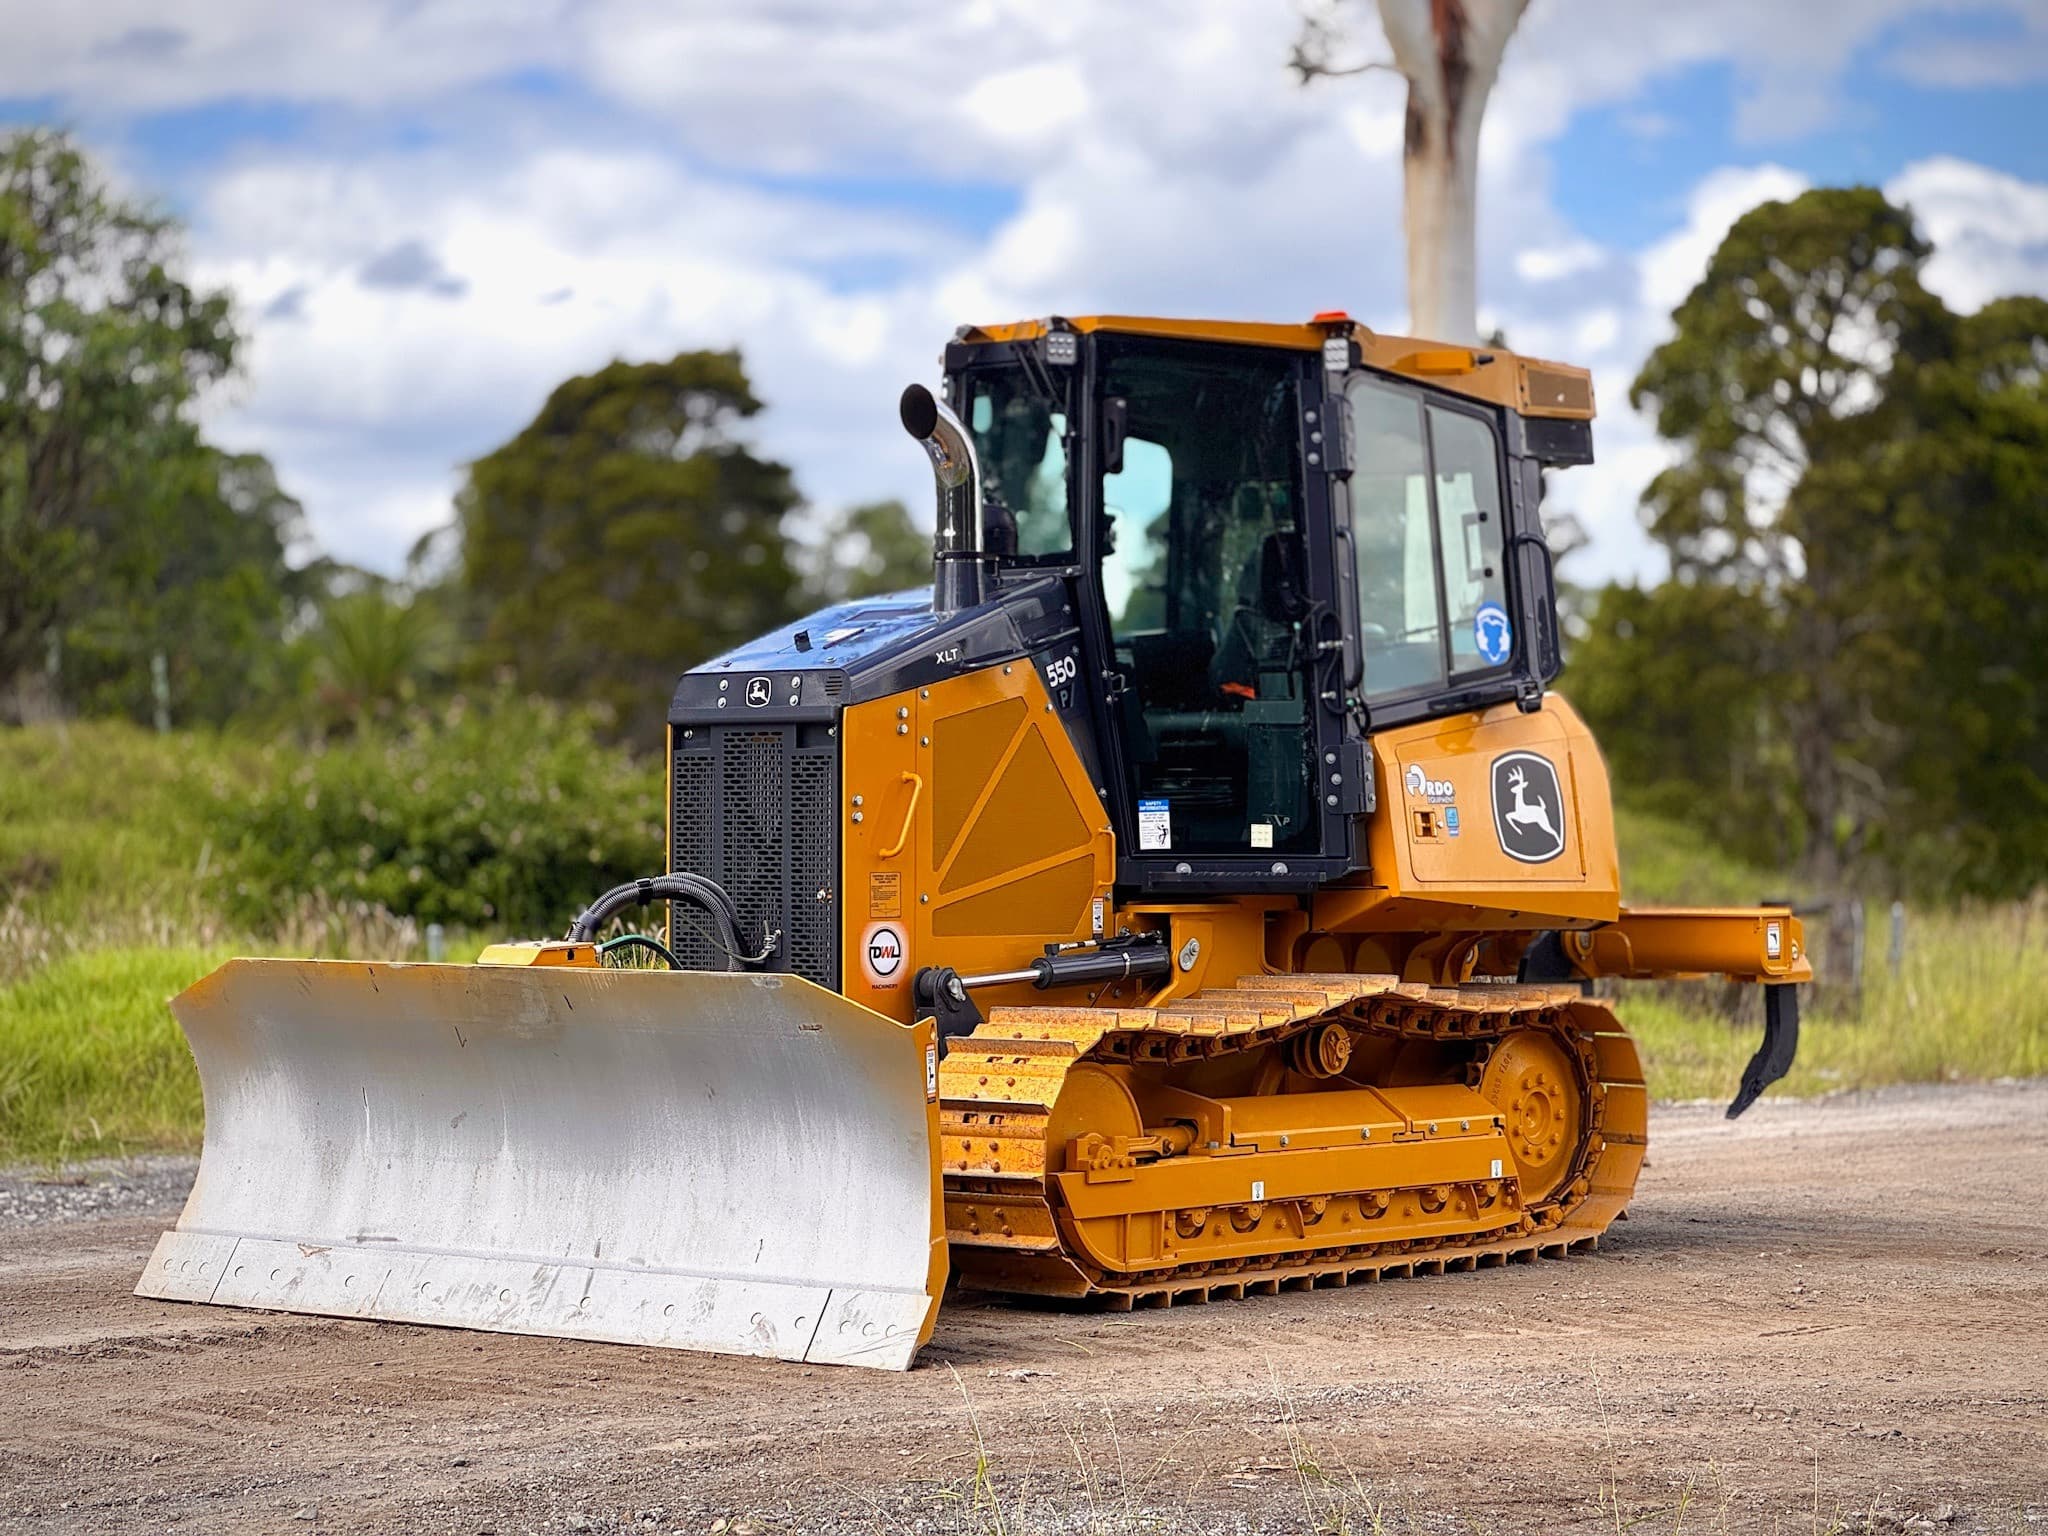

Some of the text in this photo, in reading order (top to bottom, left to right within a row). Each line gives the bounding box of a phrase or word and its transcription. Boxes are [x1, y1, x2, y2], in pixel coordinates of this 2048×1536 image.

[935, 648, 958, 665] XLT
[1046, 656, 1076, 688] 550
[1060, 690, 1069, 708] P
[869, 945, 901, 959] DWL
